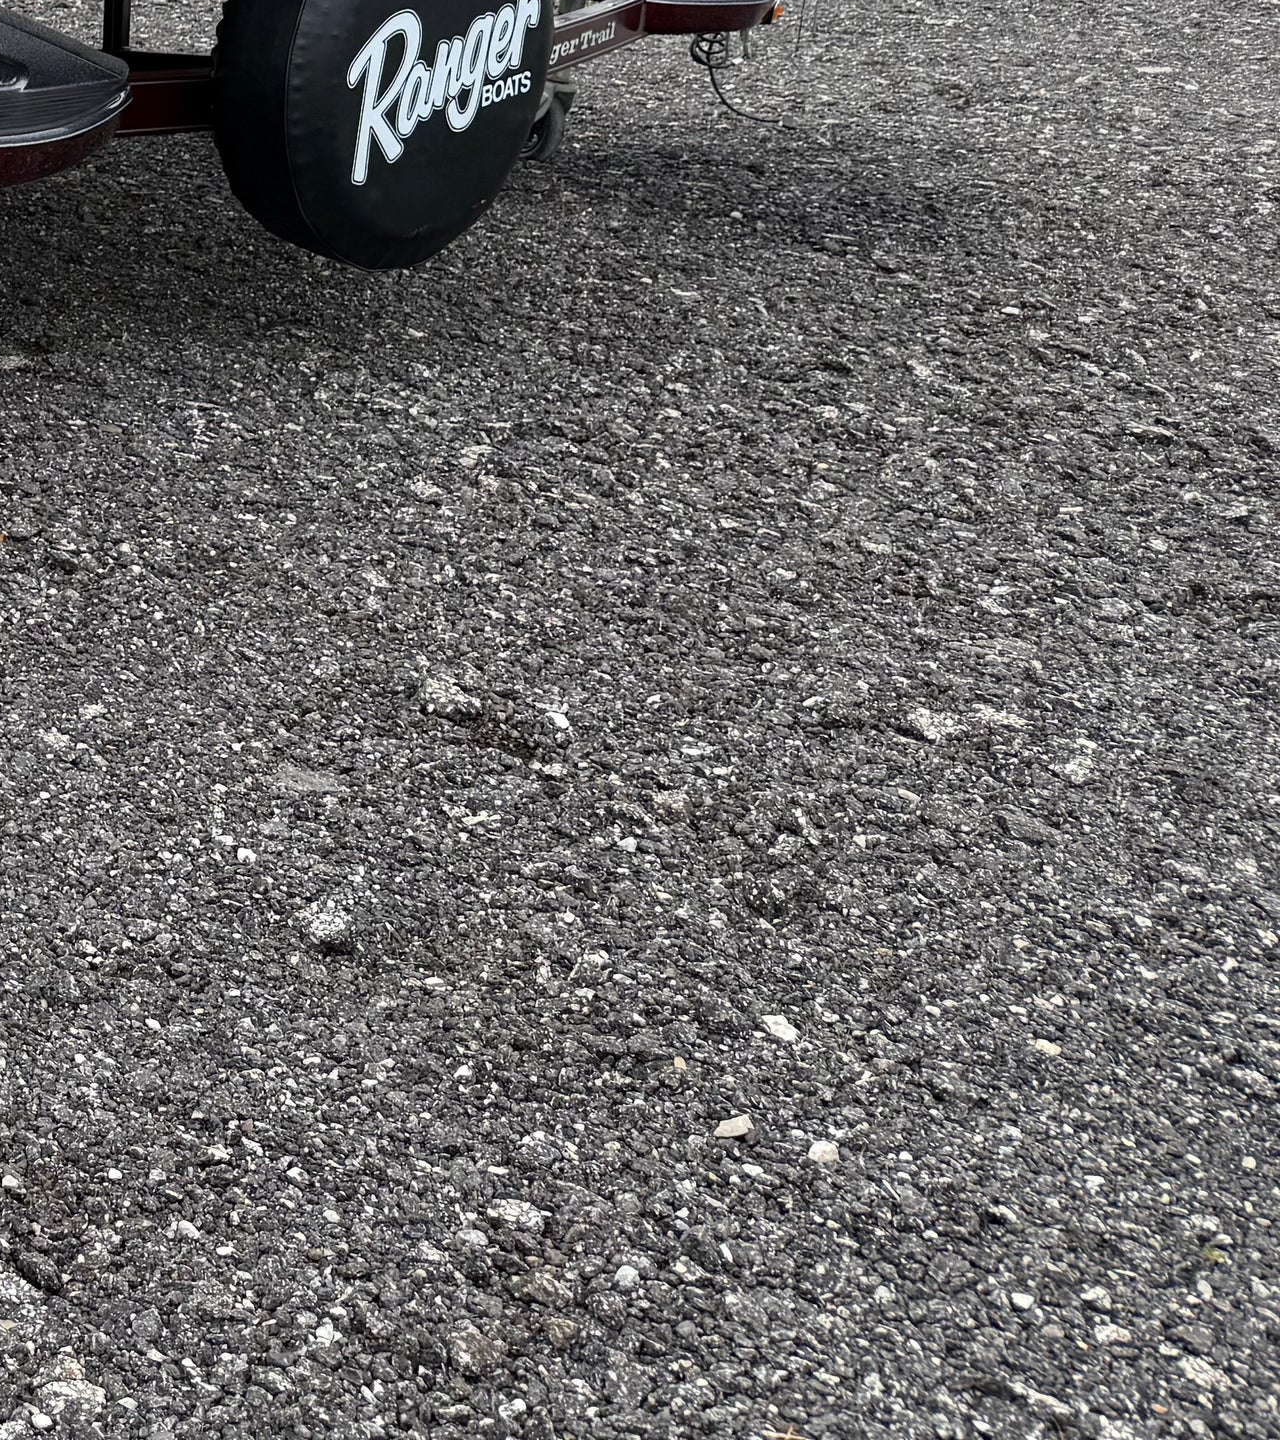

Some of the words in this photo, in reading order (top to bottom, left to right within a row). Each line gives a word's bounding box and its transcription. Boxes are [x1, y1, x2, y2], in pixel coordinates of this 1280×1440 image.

[548, 38, 579, 65] ger
[579, 21, 616, 50] Trail
[481, 71, 531, 107] BOATS
